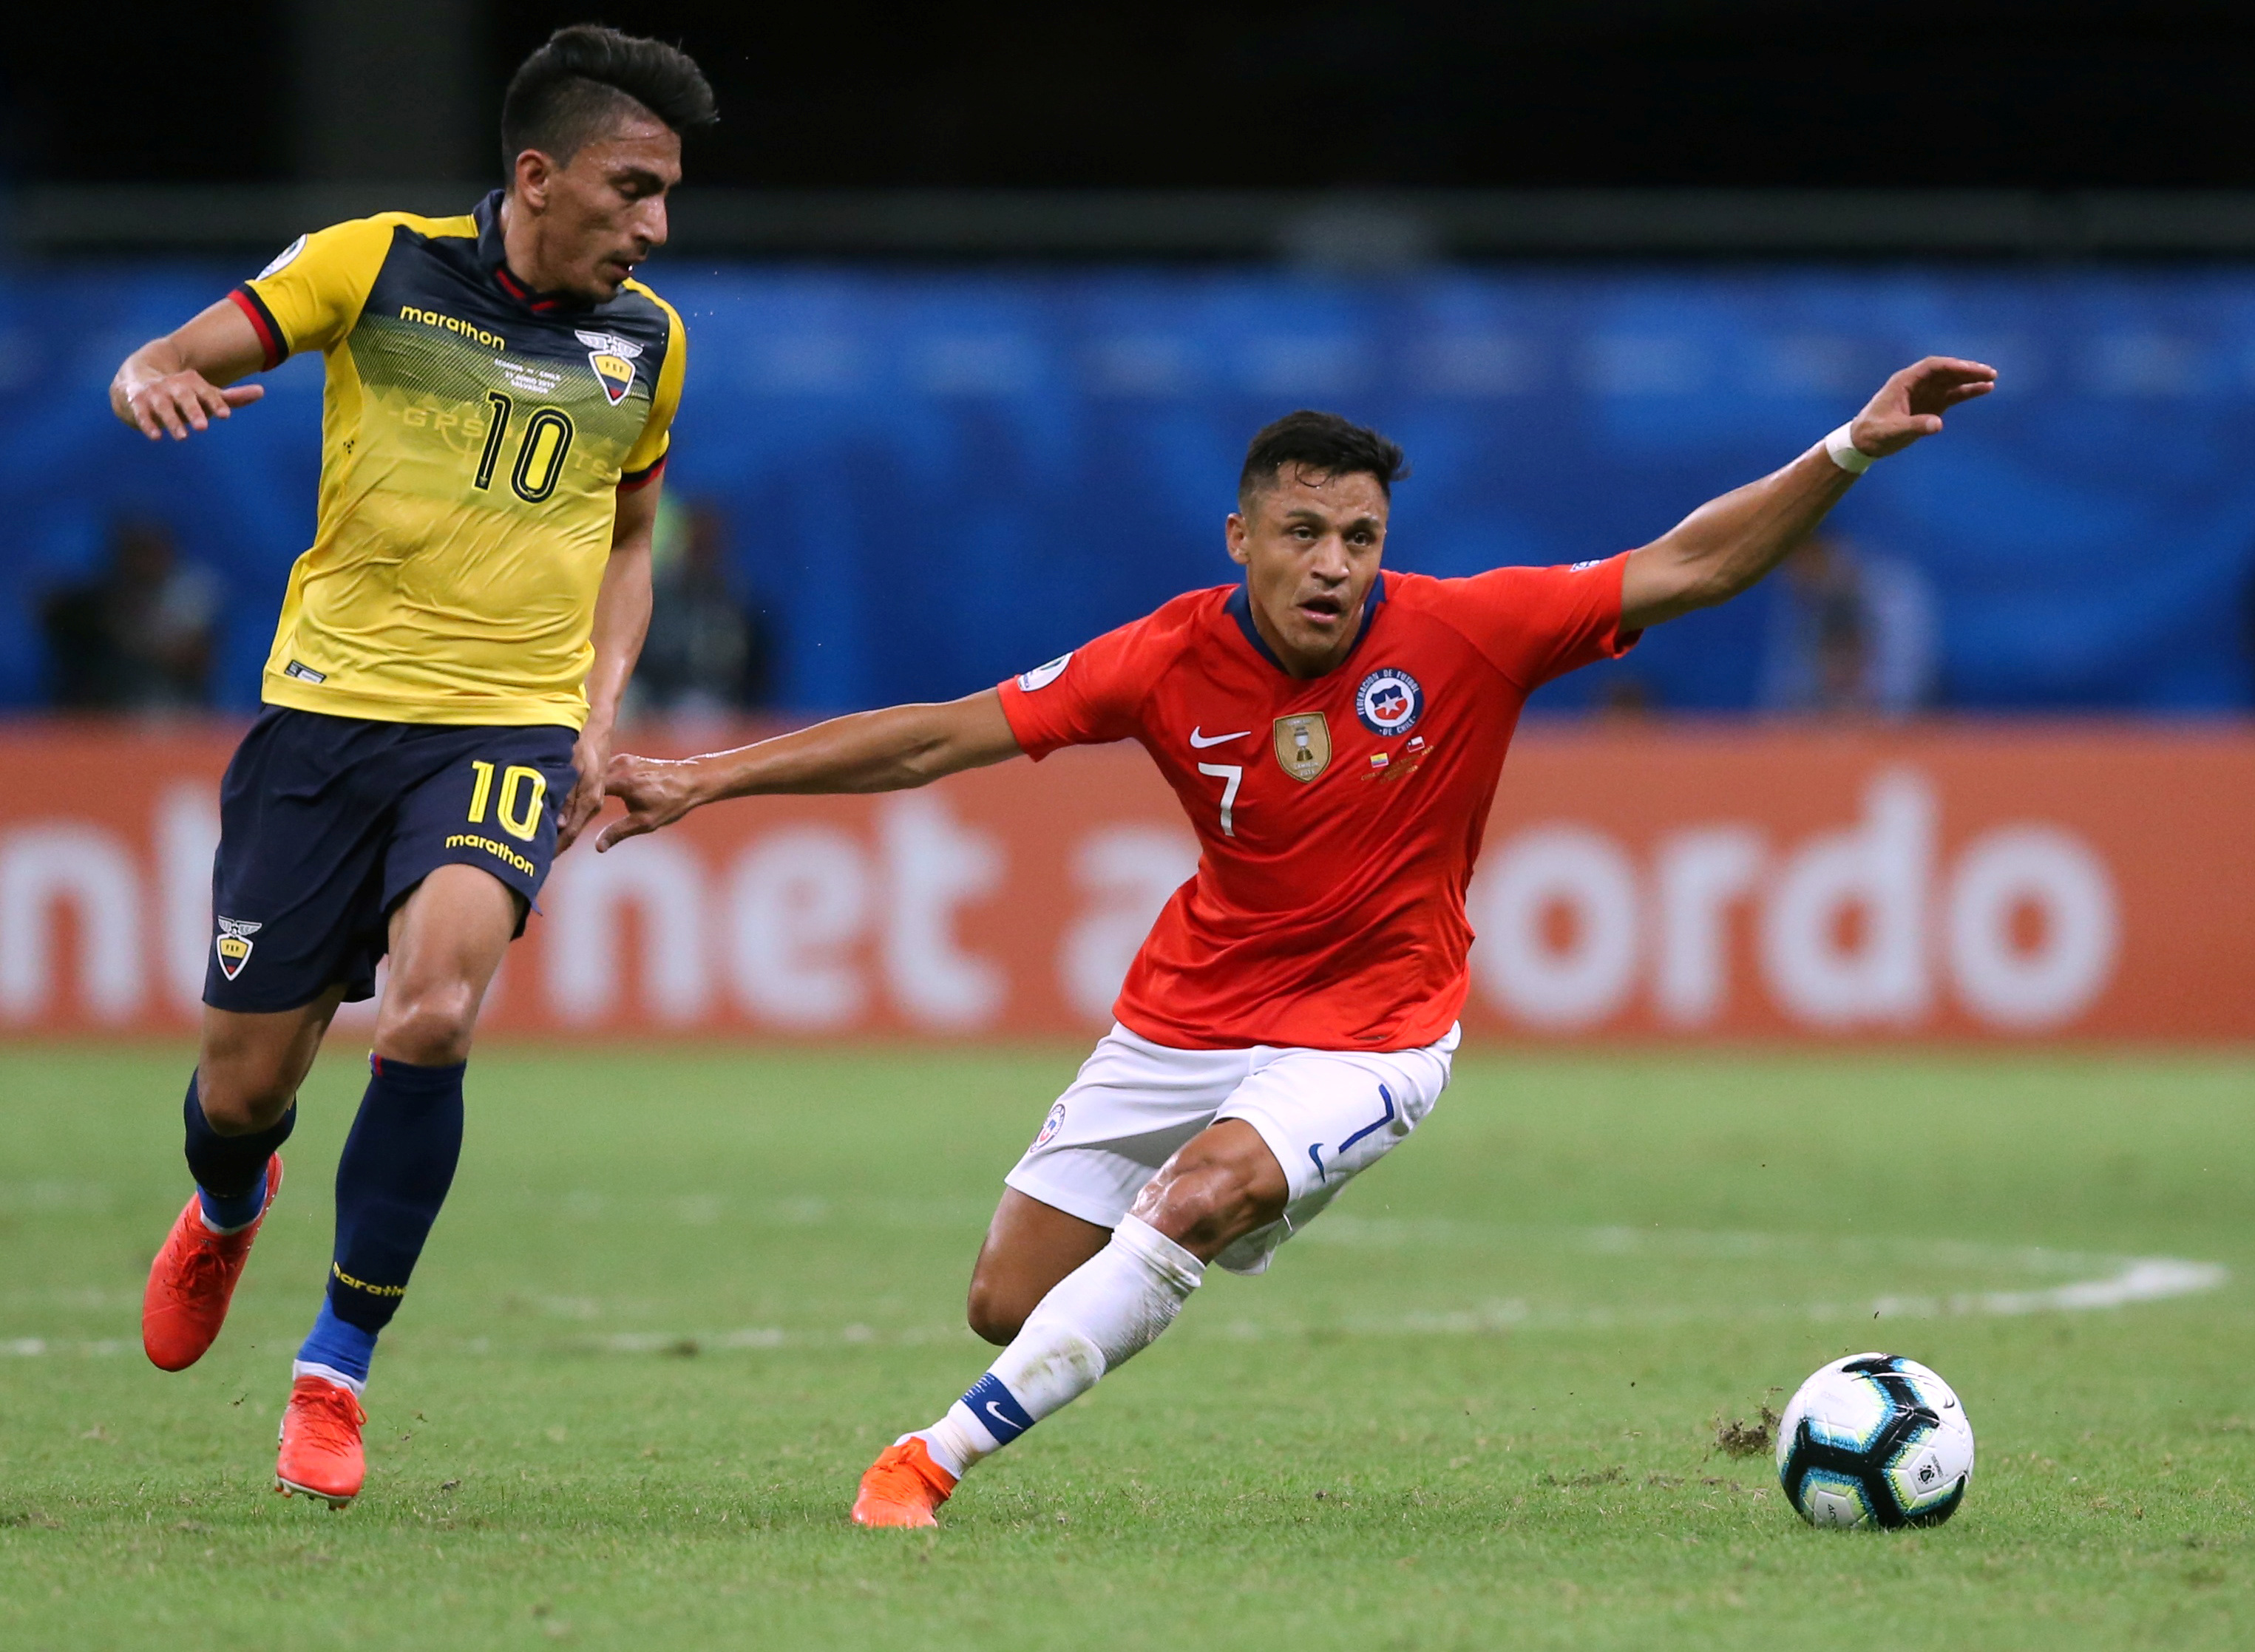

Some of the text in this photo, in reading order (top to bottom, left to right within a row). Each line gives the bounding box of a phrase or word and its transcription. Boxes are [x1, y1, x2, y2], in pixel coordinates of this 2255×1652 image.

[400, 305, 506, 351] marathon
[472, 388, 576, 504] 10
[1383, 669, 1393, 678] DE
[1383, 718, 1416, 736] DE CHILE
[467, 760, 547, 842] 10
[1198, 761, 1243, 837] 7
[445, 834, 535, 877] marathon
[1473, 763, 2122, 1035] ordo
